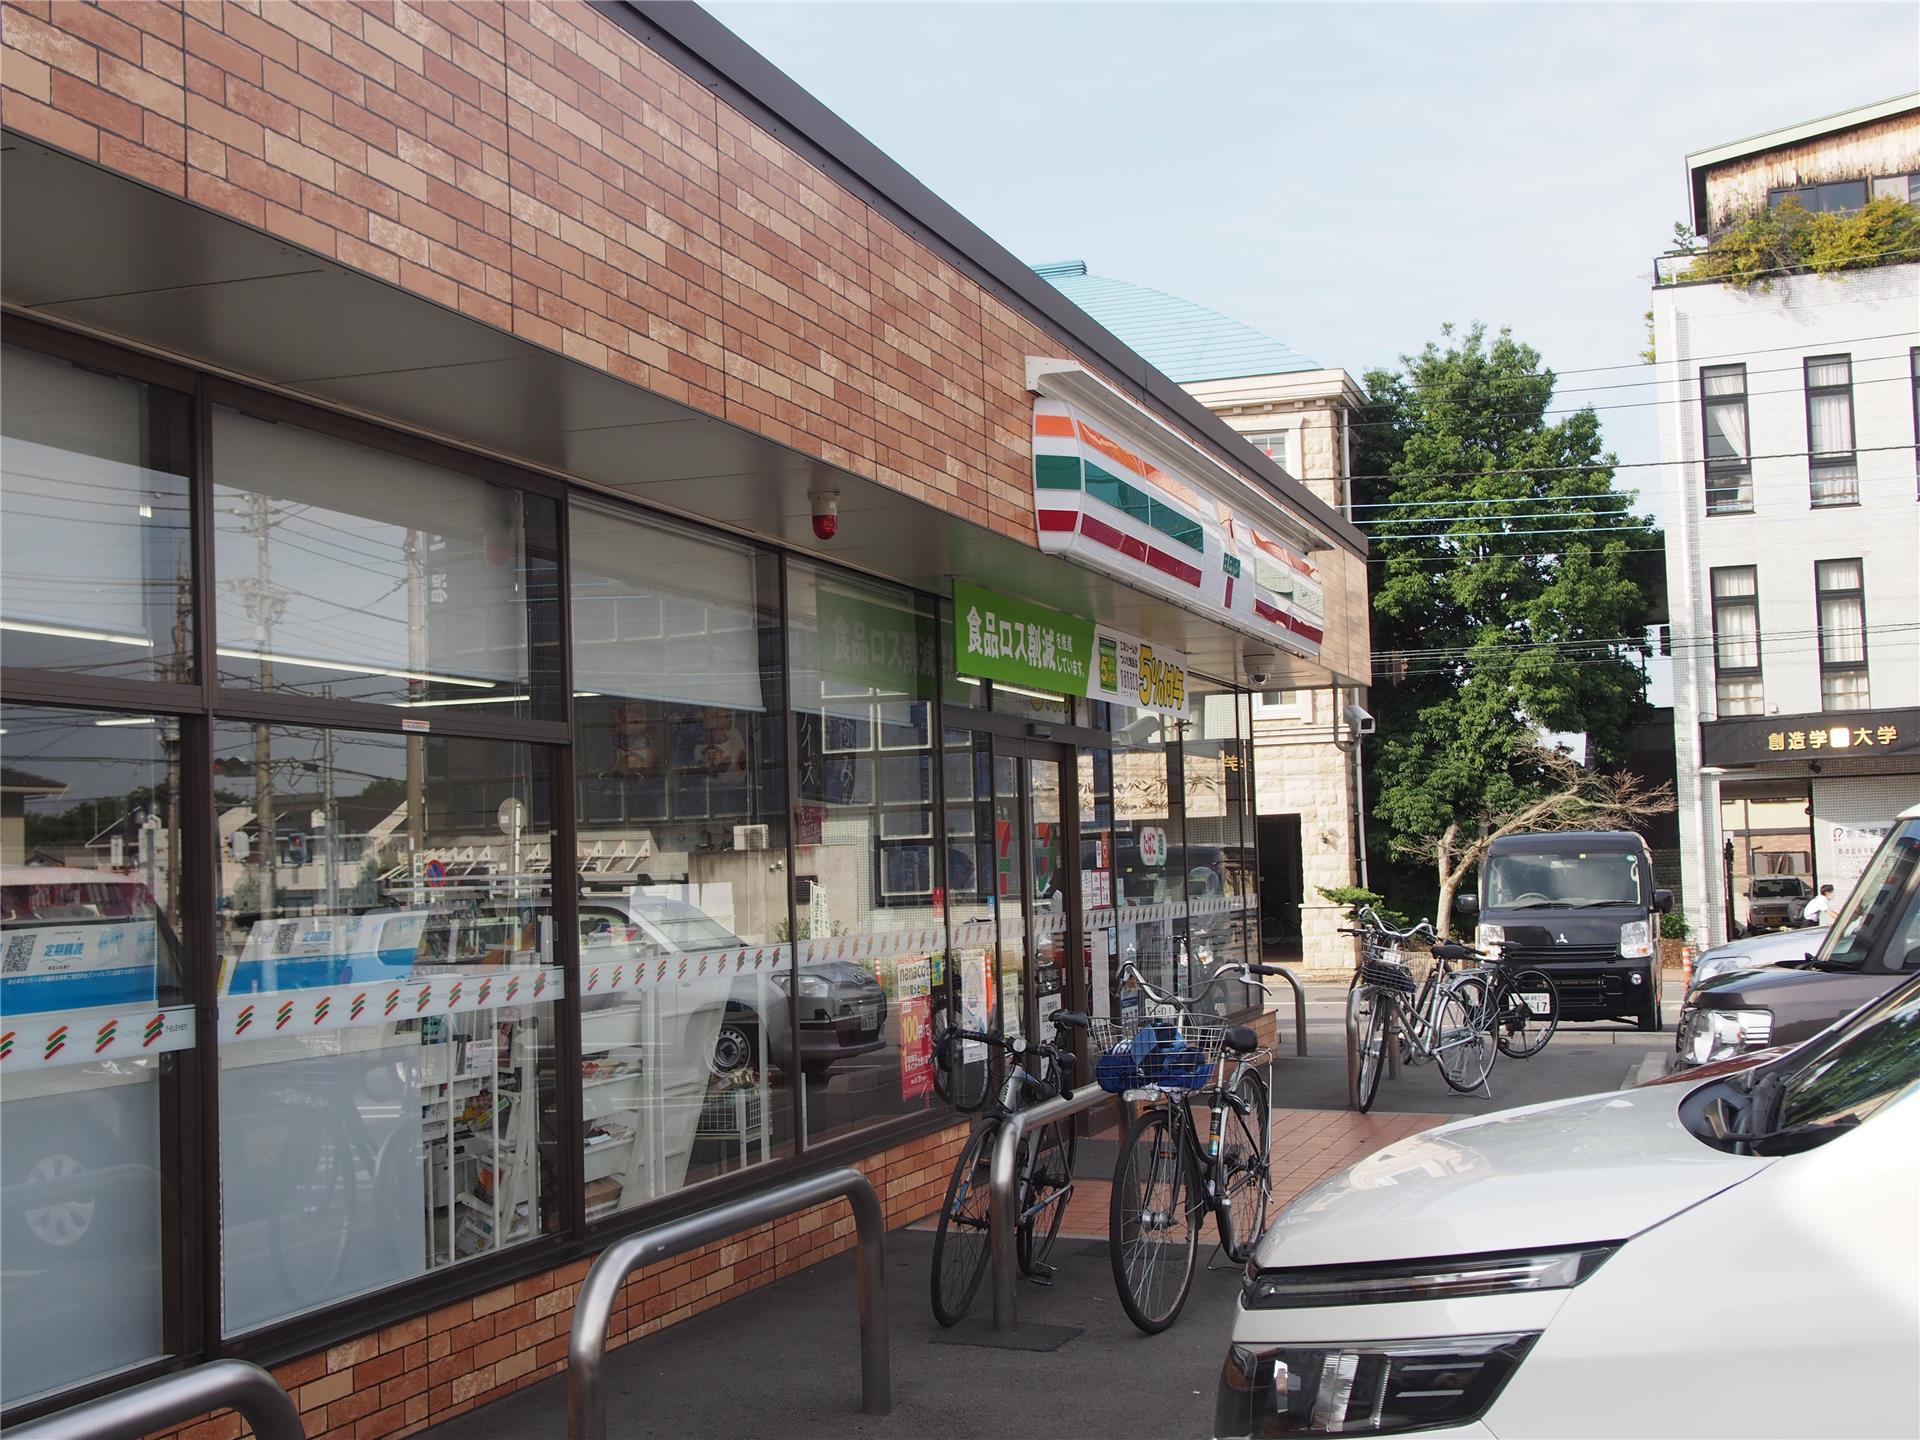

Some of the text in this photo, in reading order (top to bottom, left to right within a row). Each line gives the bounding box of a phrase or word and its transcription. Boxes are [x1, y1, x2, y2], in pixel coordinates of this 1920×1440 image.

[966, 606, 1056, 672] 食品ロス削減
[1056, 656, 1085, 678] しています。
[1768, 726, 1897, 751] 創造学大学
